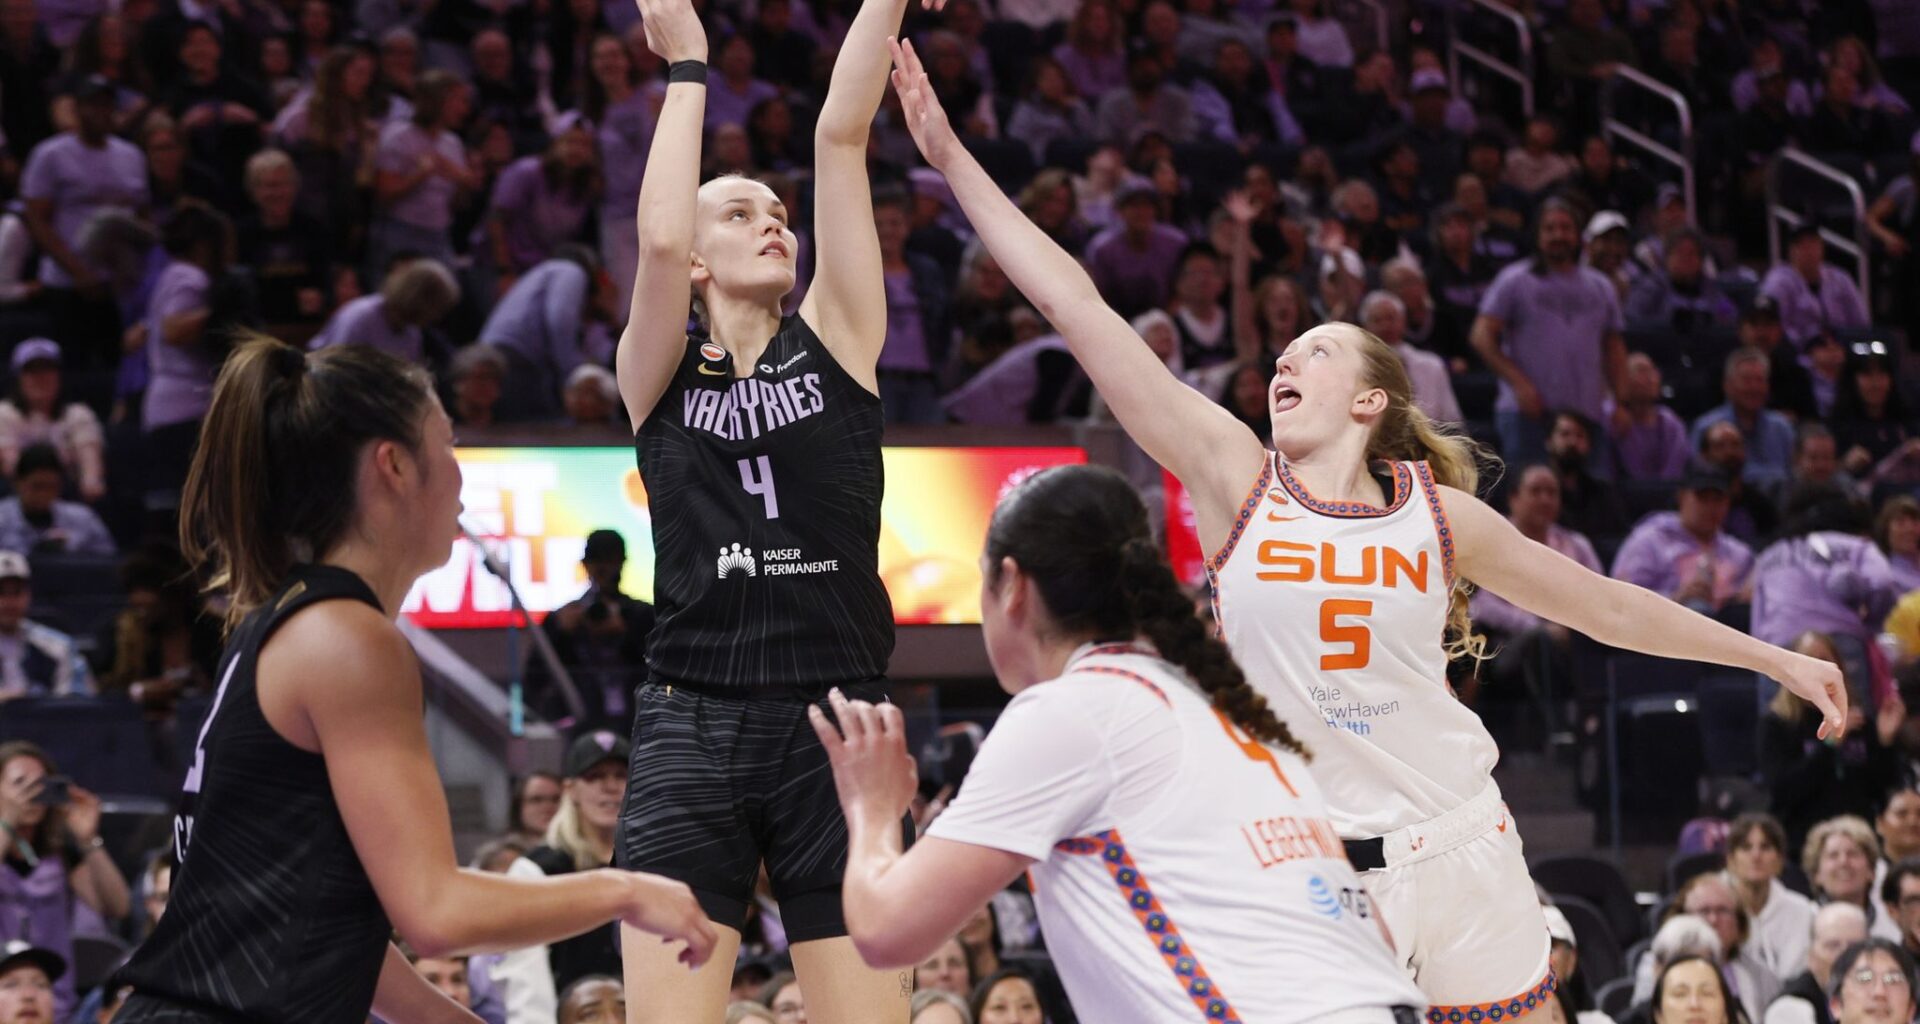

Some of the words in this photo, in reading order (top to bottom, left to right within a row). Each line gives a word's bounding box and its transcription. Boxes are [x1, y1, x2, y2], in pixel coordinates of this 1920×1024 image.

[776, 350, 808, 373] freedom
[683, 373, 824, 441] VALKYRIES
[737, 455, 779, 520] 4
[763, 548, 801, 561] KAISER
[764, 559, 839, 576] PERMANENTE
[1256, 539, 1428, 594] SUN
[1319, 598, 1373, 671] 5
[1307, 686, 1342, 701] Yale
[1319, 699, 1400, 719] ewHaven
[1324, 716, 1371, 736] Hlth
